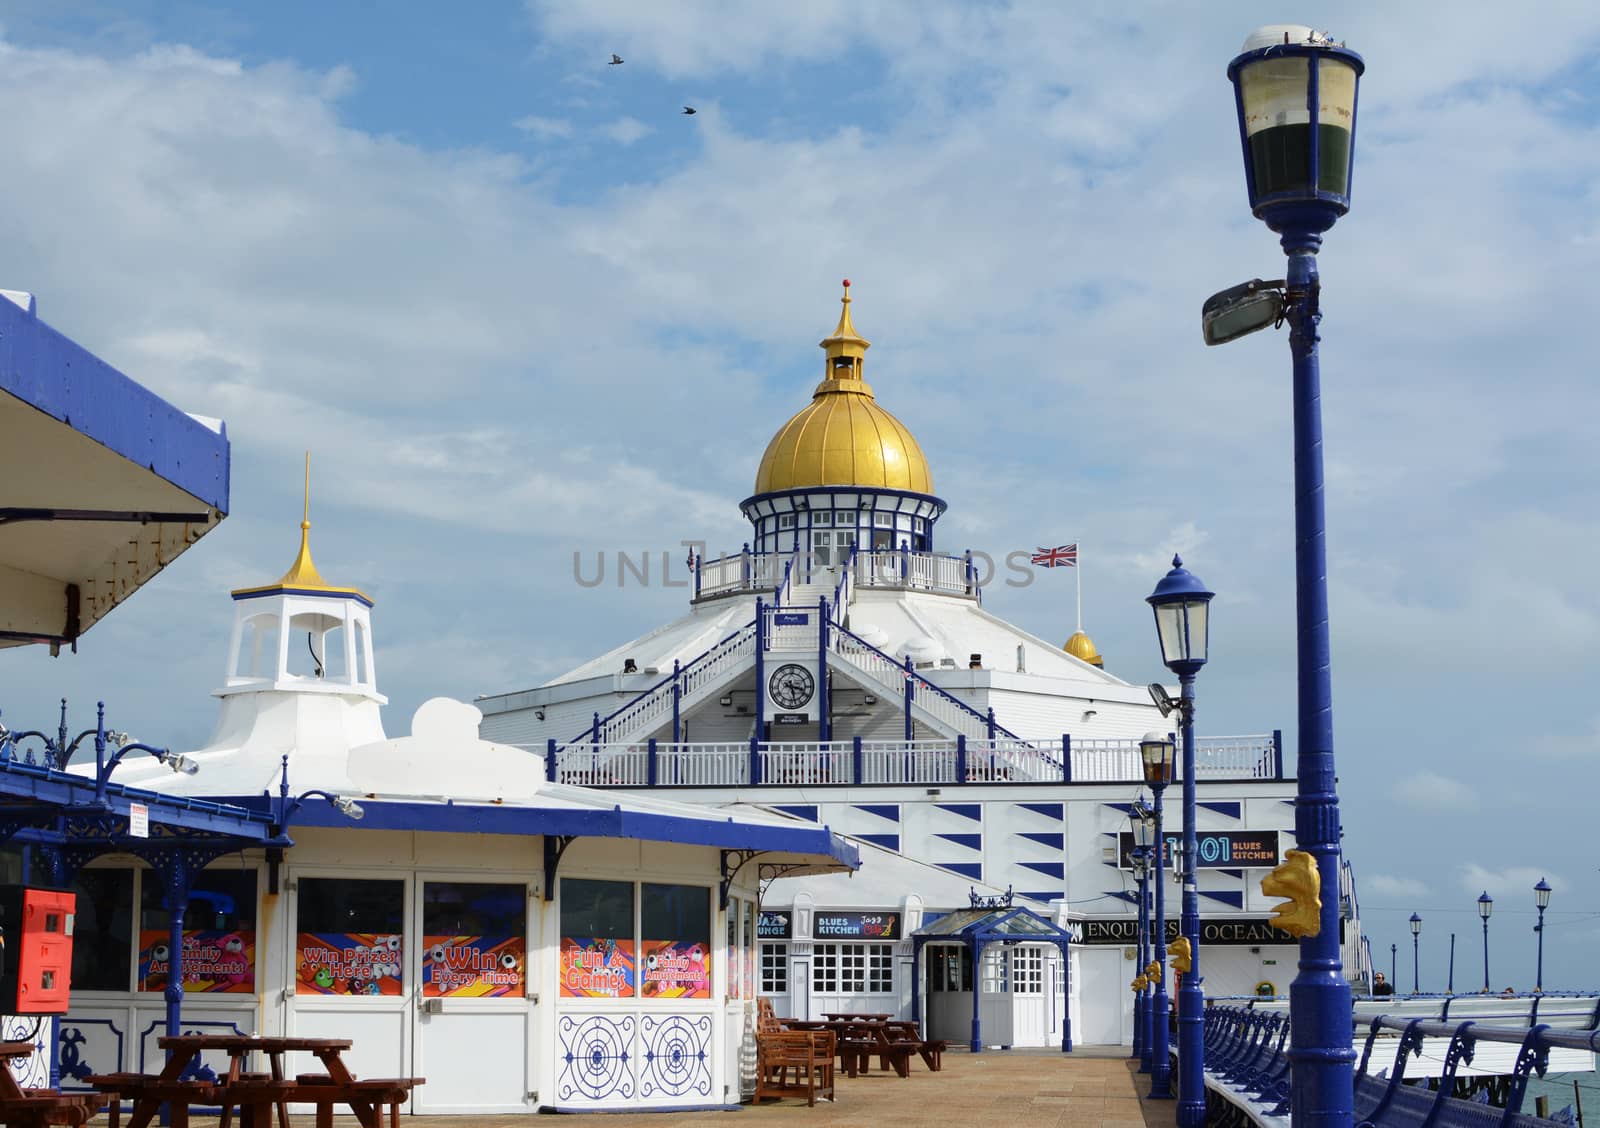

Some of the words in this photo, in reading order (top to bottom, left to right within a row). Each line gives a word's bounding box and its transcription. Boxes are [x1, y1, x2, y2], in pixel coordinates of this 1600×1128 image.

[1167, 837, 1230, 862] 101
[1232, 842, 1262, 850] BLUES
[1232, 851, 1274, 860] KITCHEN
[818, 918, 849, 926] BLUES
[1088, 922, 1178, 938] ENQUIIS
[818, 926, 860, 935] KITCHEN
[1204, 924, 1274, 940] OCEAN
[181, 946, 222, 963] amily
[303, 947, 339, 964] Win
[344, 948, 397, 964] Prizes
[444, 946, 498, 970] Win
[569, 946, 605, 969] Fun
[609, 953, 623, 969] &
[656, 954, 690, 970] Family
[329, 963, 371, 979] Here
[431, 969, 475, 986] Every
[480, 969, 519, 985] Time
[565, 967, 627, 991] Games
[644, 967, 703, 981] Amusements
